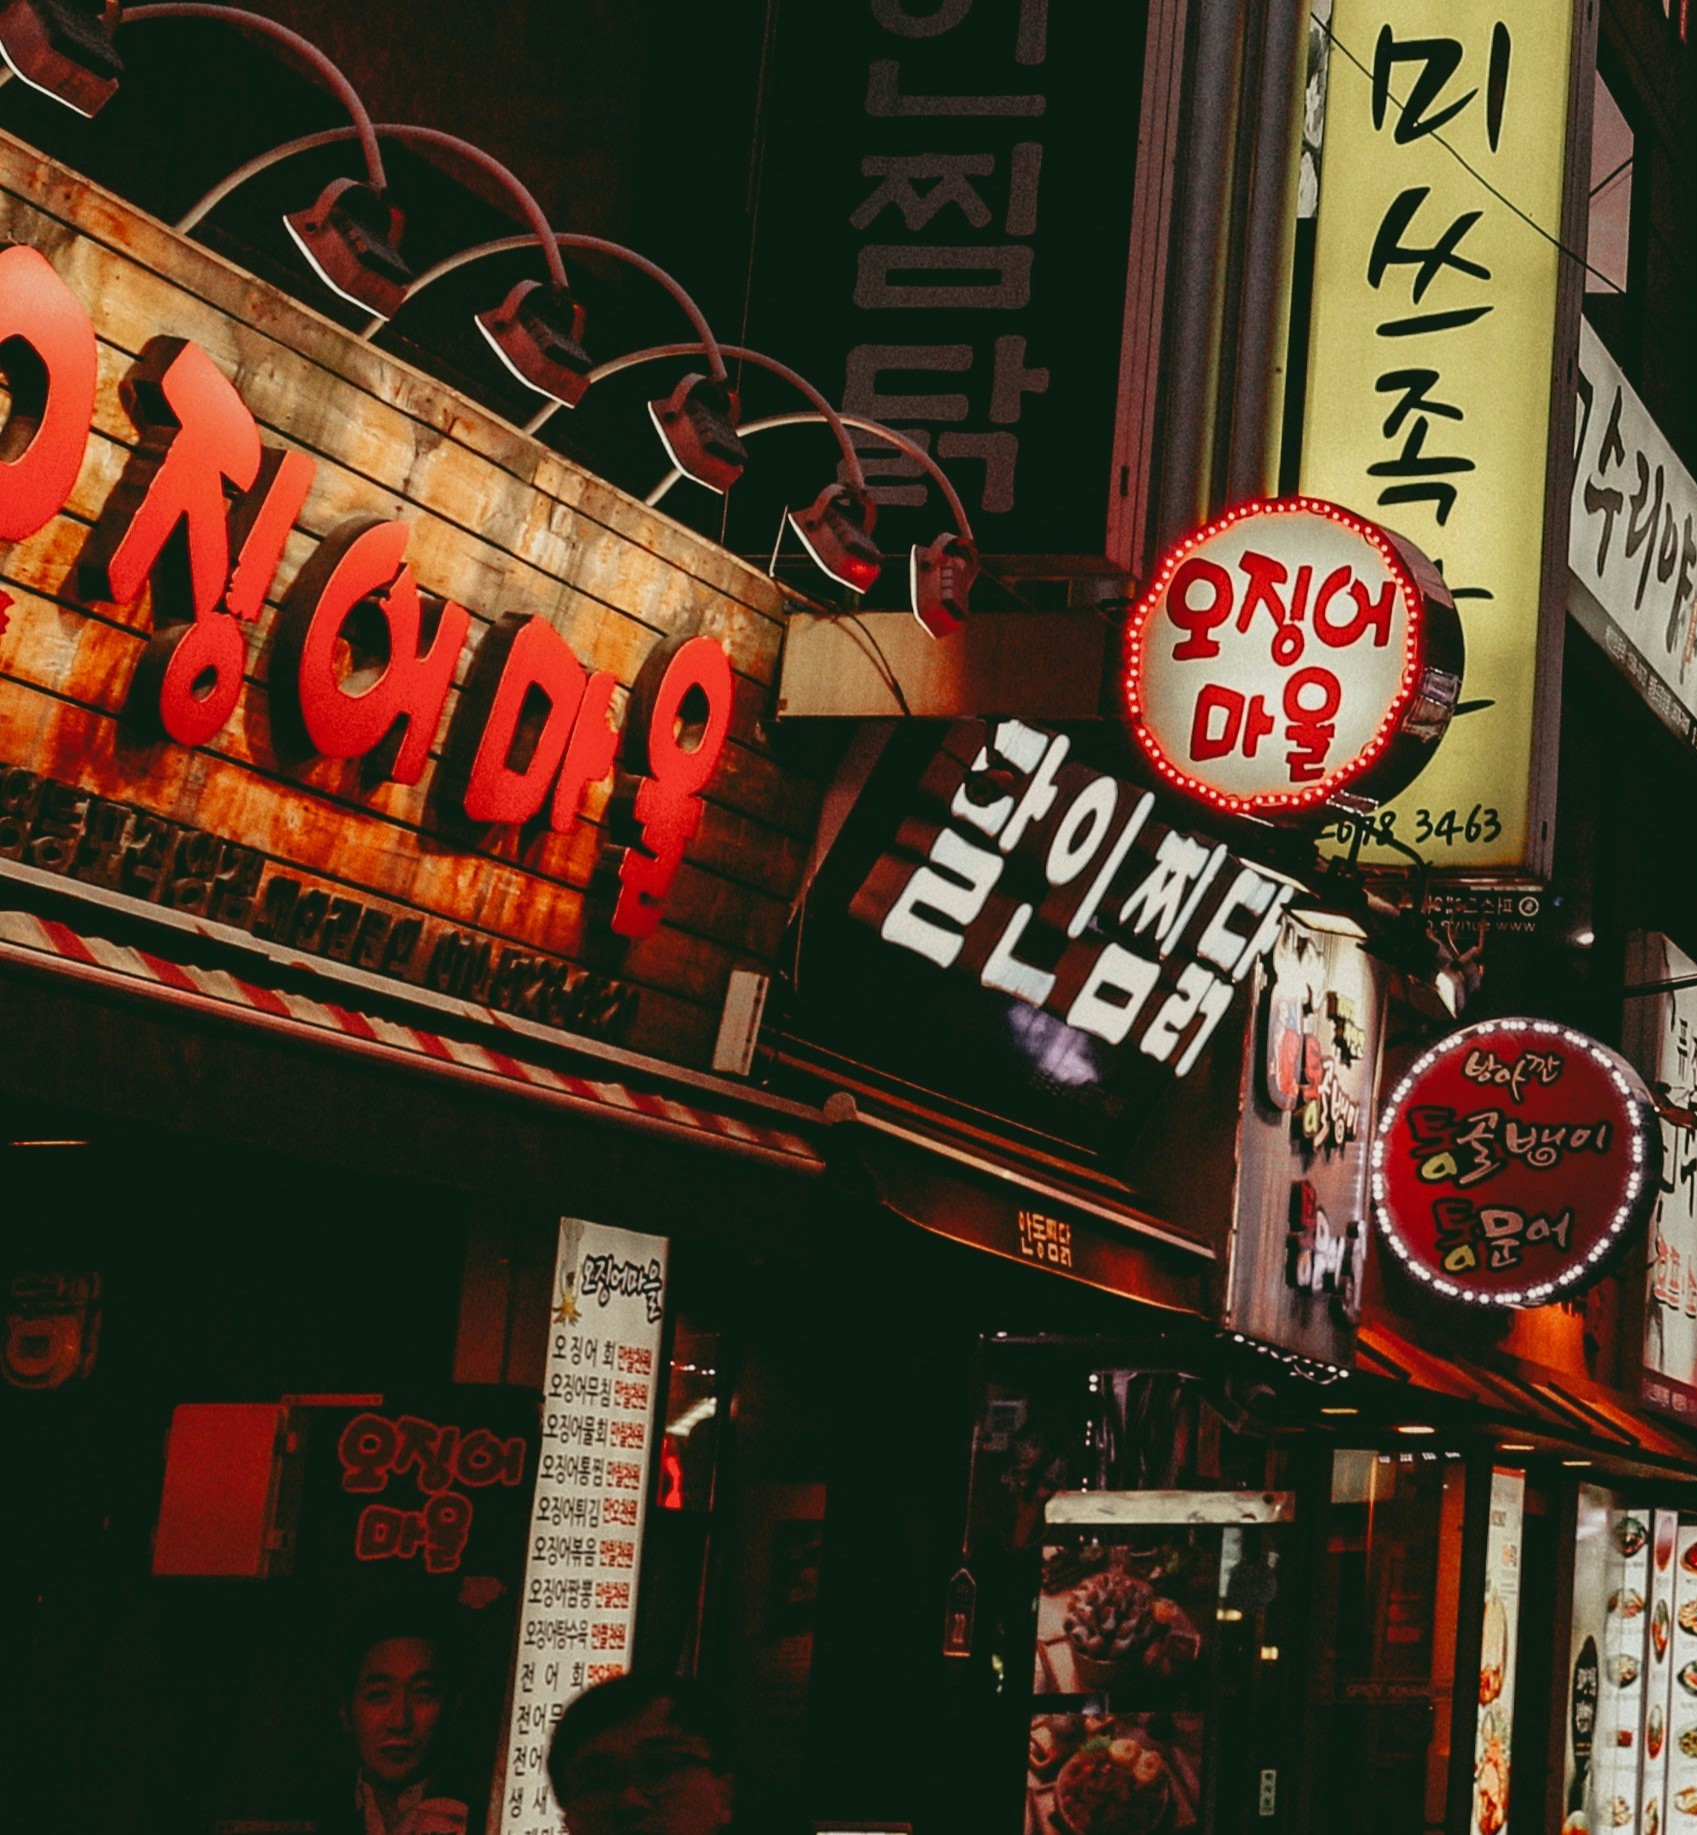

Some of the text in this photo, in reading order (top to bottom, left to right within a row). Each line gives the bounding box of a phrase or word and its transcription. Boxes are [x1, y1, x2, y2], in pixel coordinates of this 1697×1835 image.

[1584, 384, 1697, 654] 수리야
[1166, 551, 1398, 668] 오징어
[1190, 666, 1342, 783] 마을
[1415, 804, 1502, 846] 3463
[1408, 1107, 1609, 1186] 통골뱅이
[1016, 1209, 1073, 1268] 안동찜닭
[1433, 1199, 1570, 1272] 통문어
[581, 1254, 663, 1324] 오징어마을
[338, 1411, 527, 1495] 오징어
[355, 1490, 474, 1574] 마을
